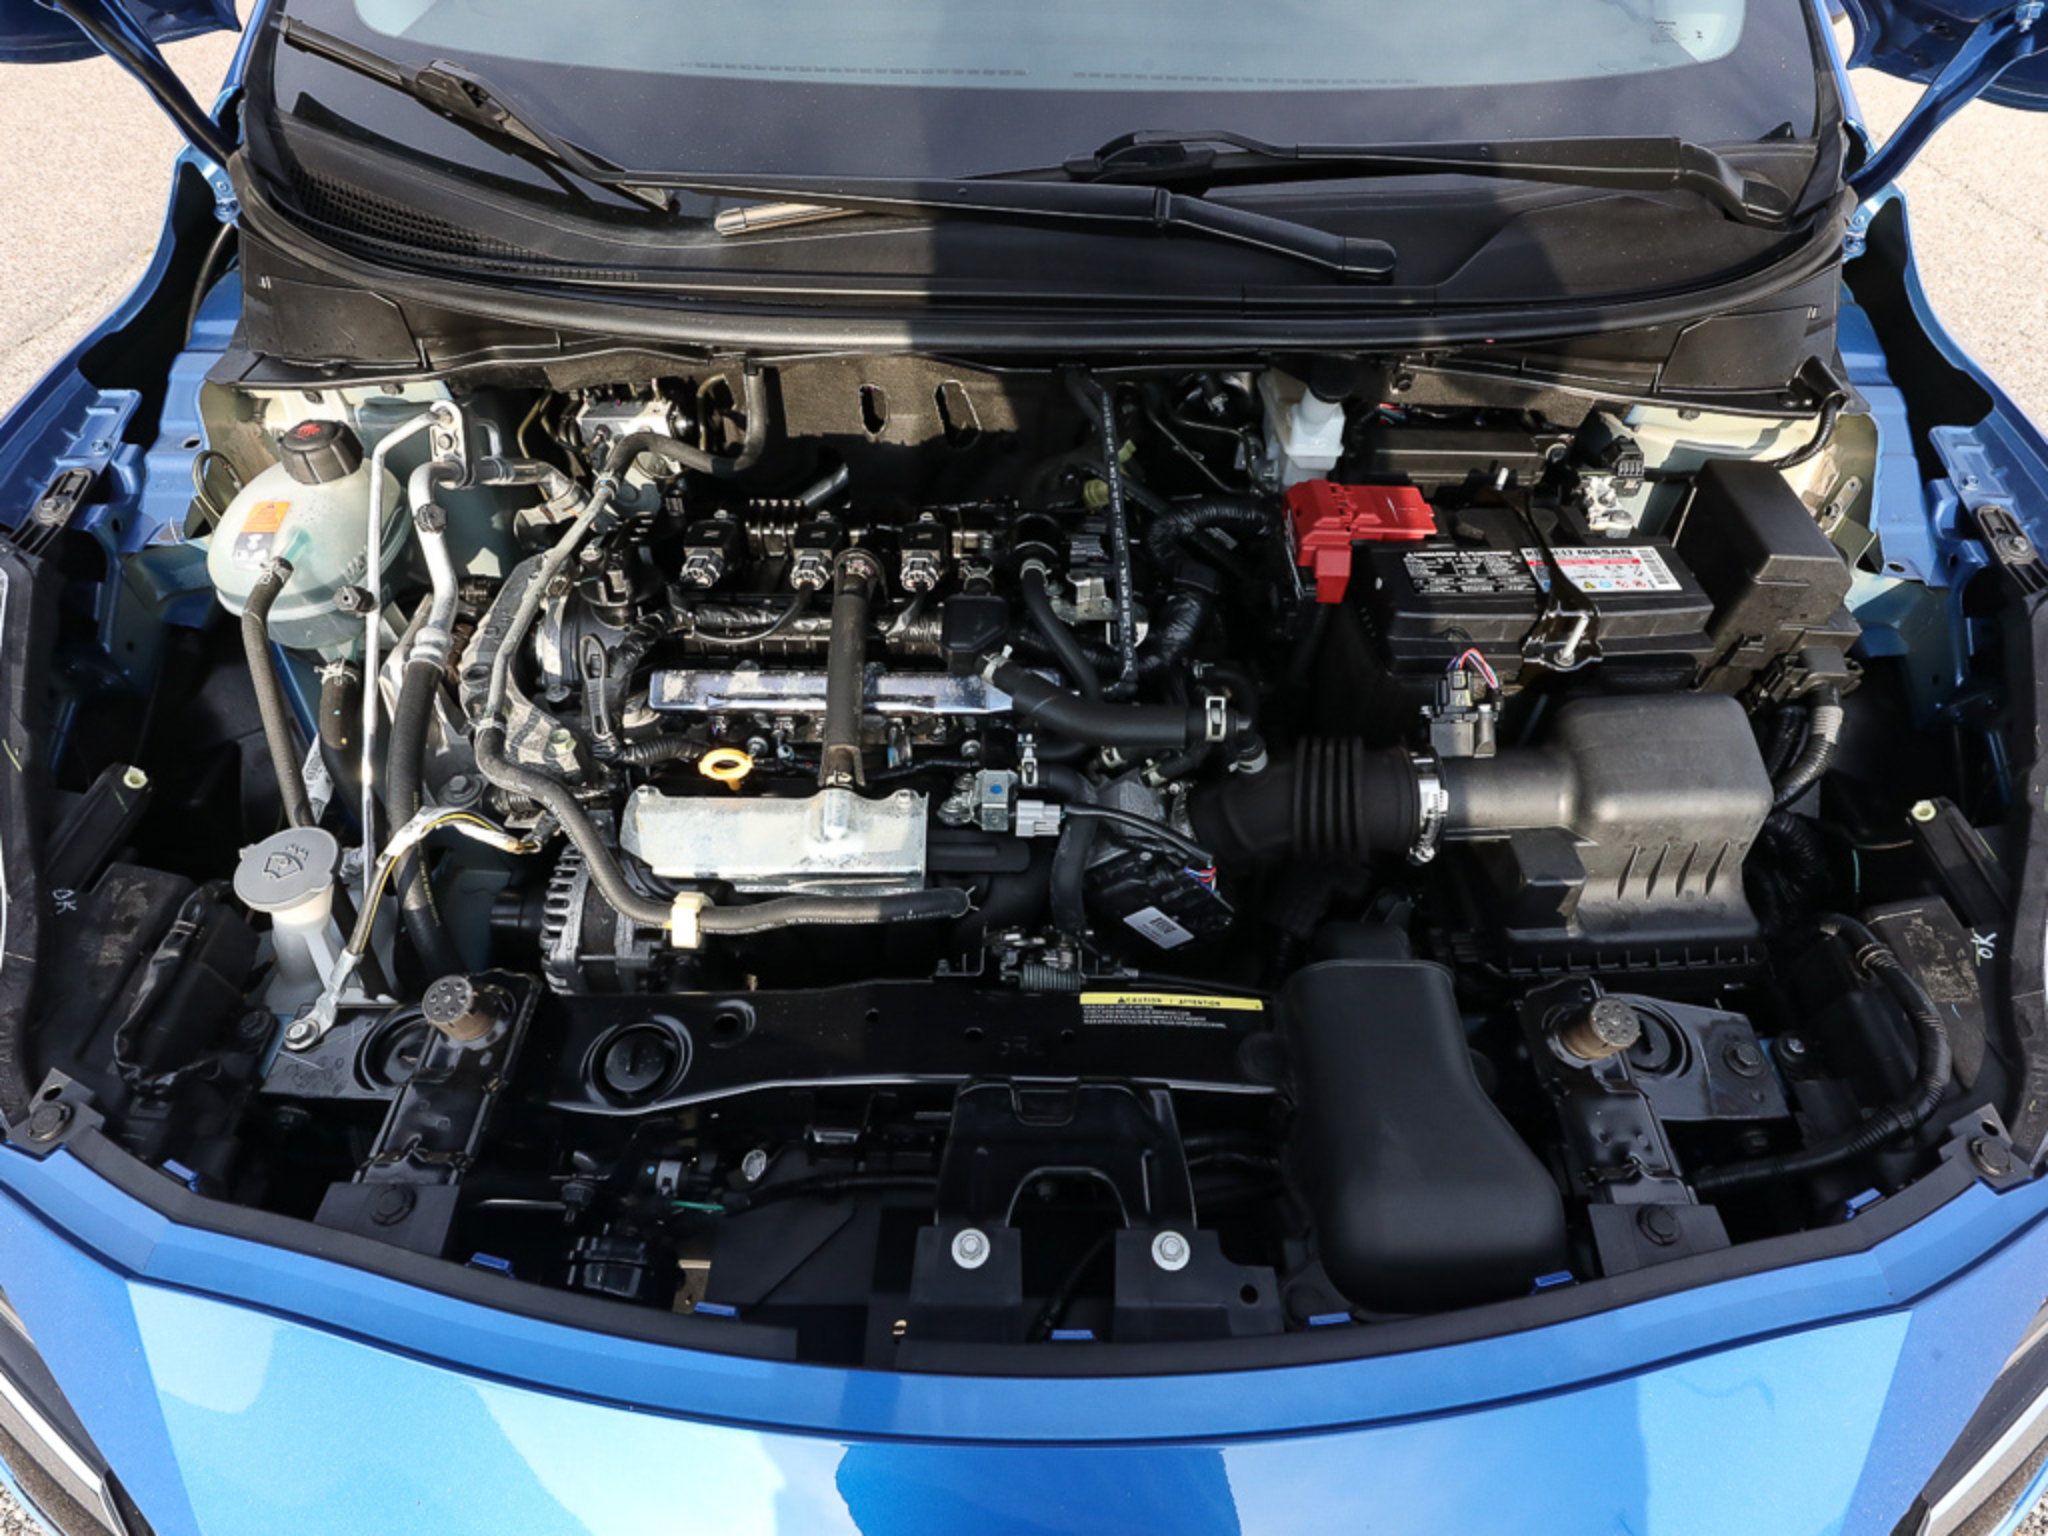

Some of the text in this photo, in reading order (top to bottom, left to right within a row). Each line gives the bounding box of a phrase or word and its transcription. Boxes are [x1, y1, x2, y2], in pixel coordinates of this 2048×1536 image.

[51, 888, 78, 915] OK
[1970, 931, 1998, 959] OK
[1178, 999, 1221, 1007] ATTENTION
